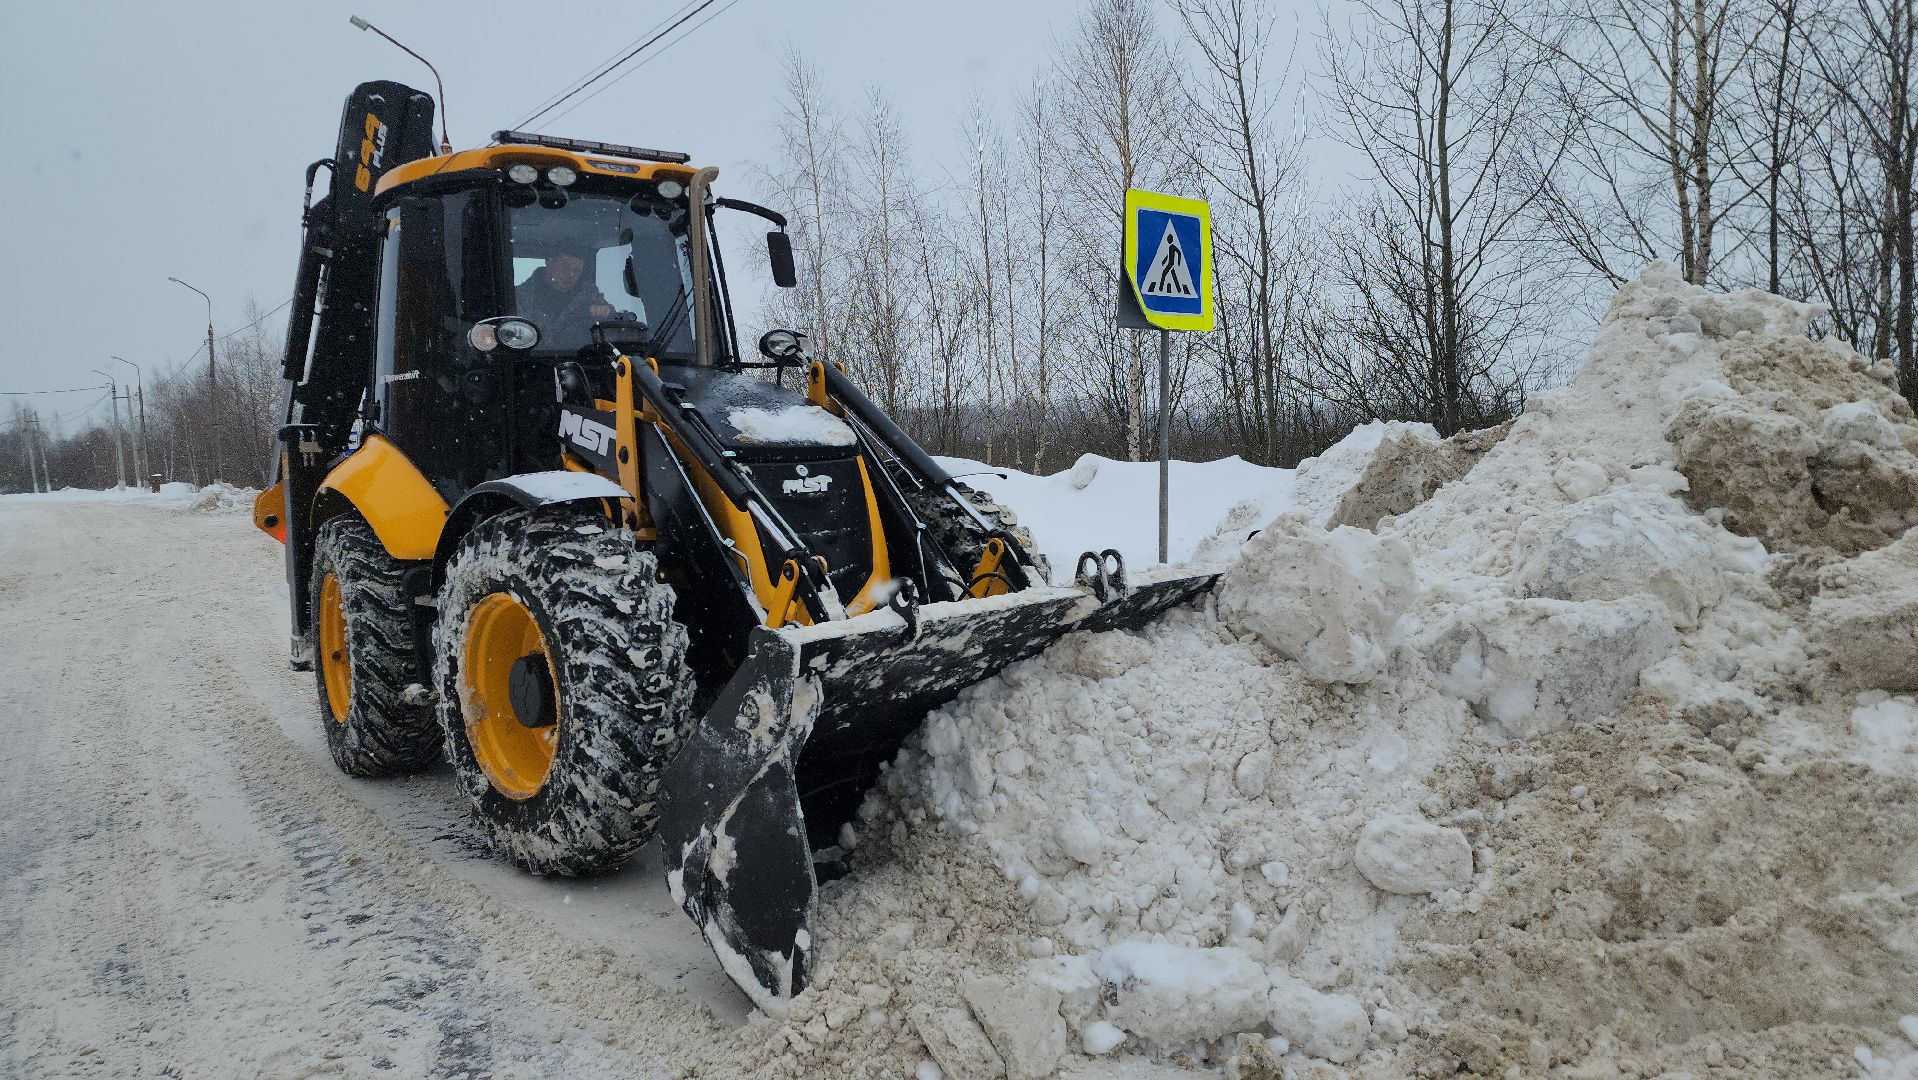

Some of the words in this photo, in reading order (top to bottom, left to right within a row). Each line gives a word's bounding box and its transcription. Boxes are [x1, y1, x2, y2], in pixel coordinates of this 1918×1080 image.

[373, 124, 387, 168] PLUS
[558, 409, 616, 457] MST
[782, 475, 832, 493] MST
